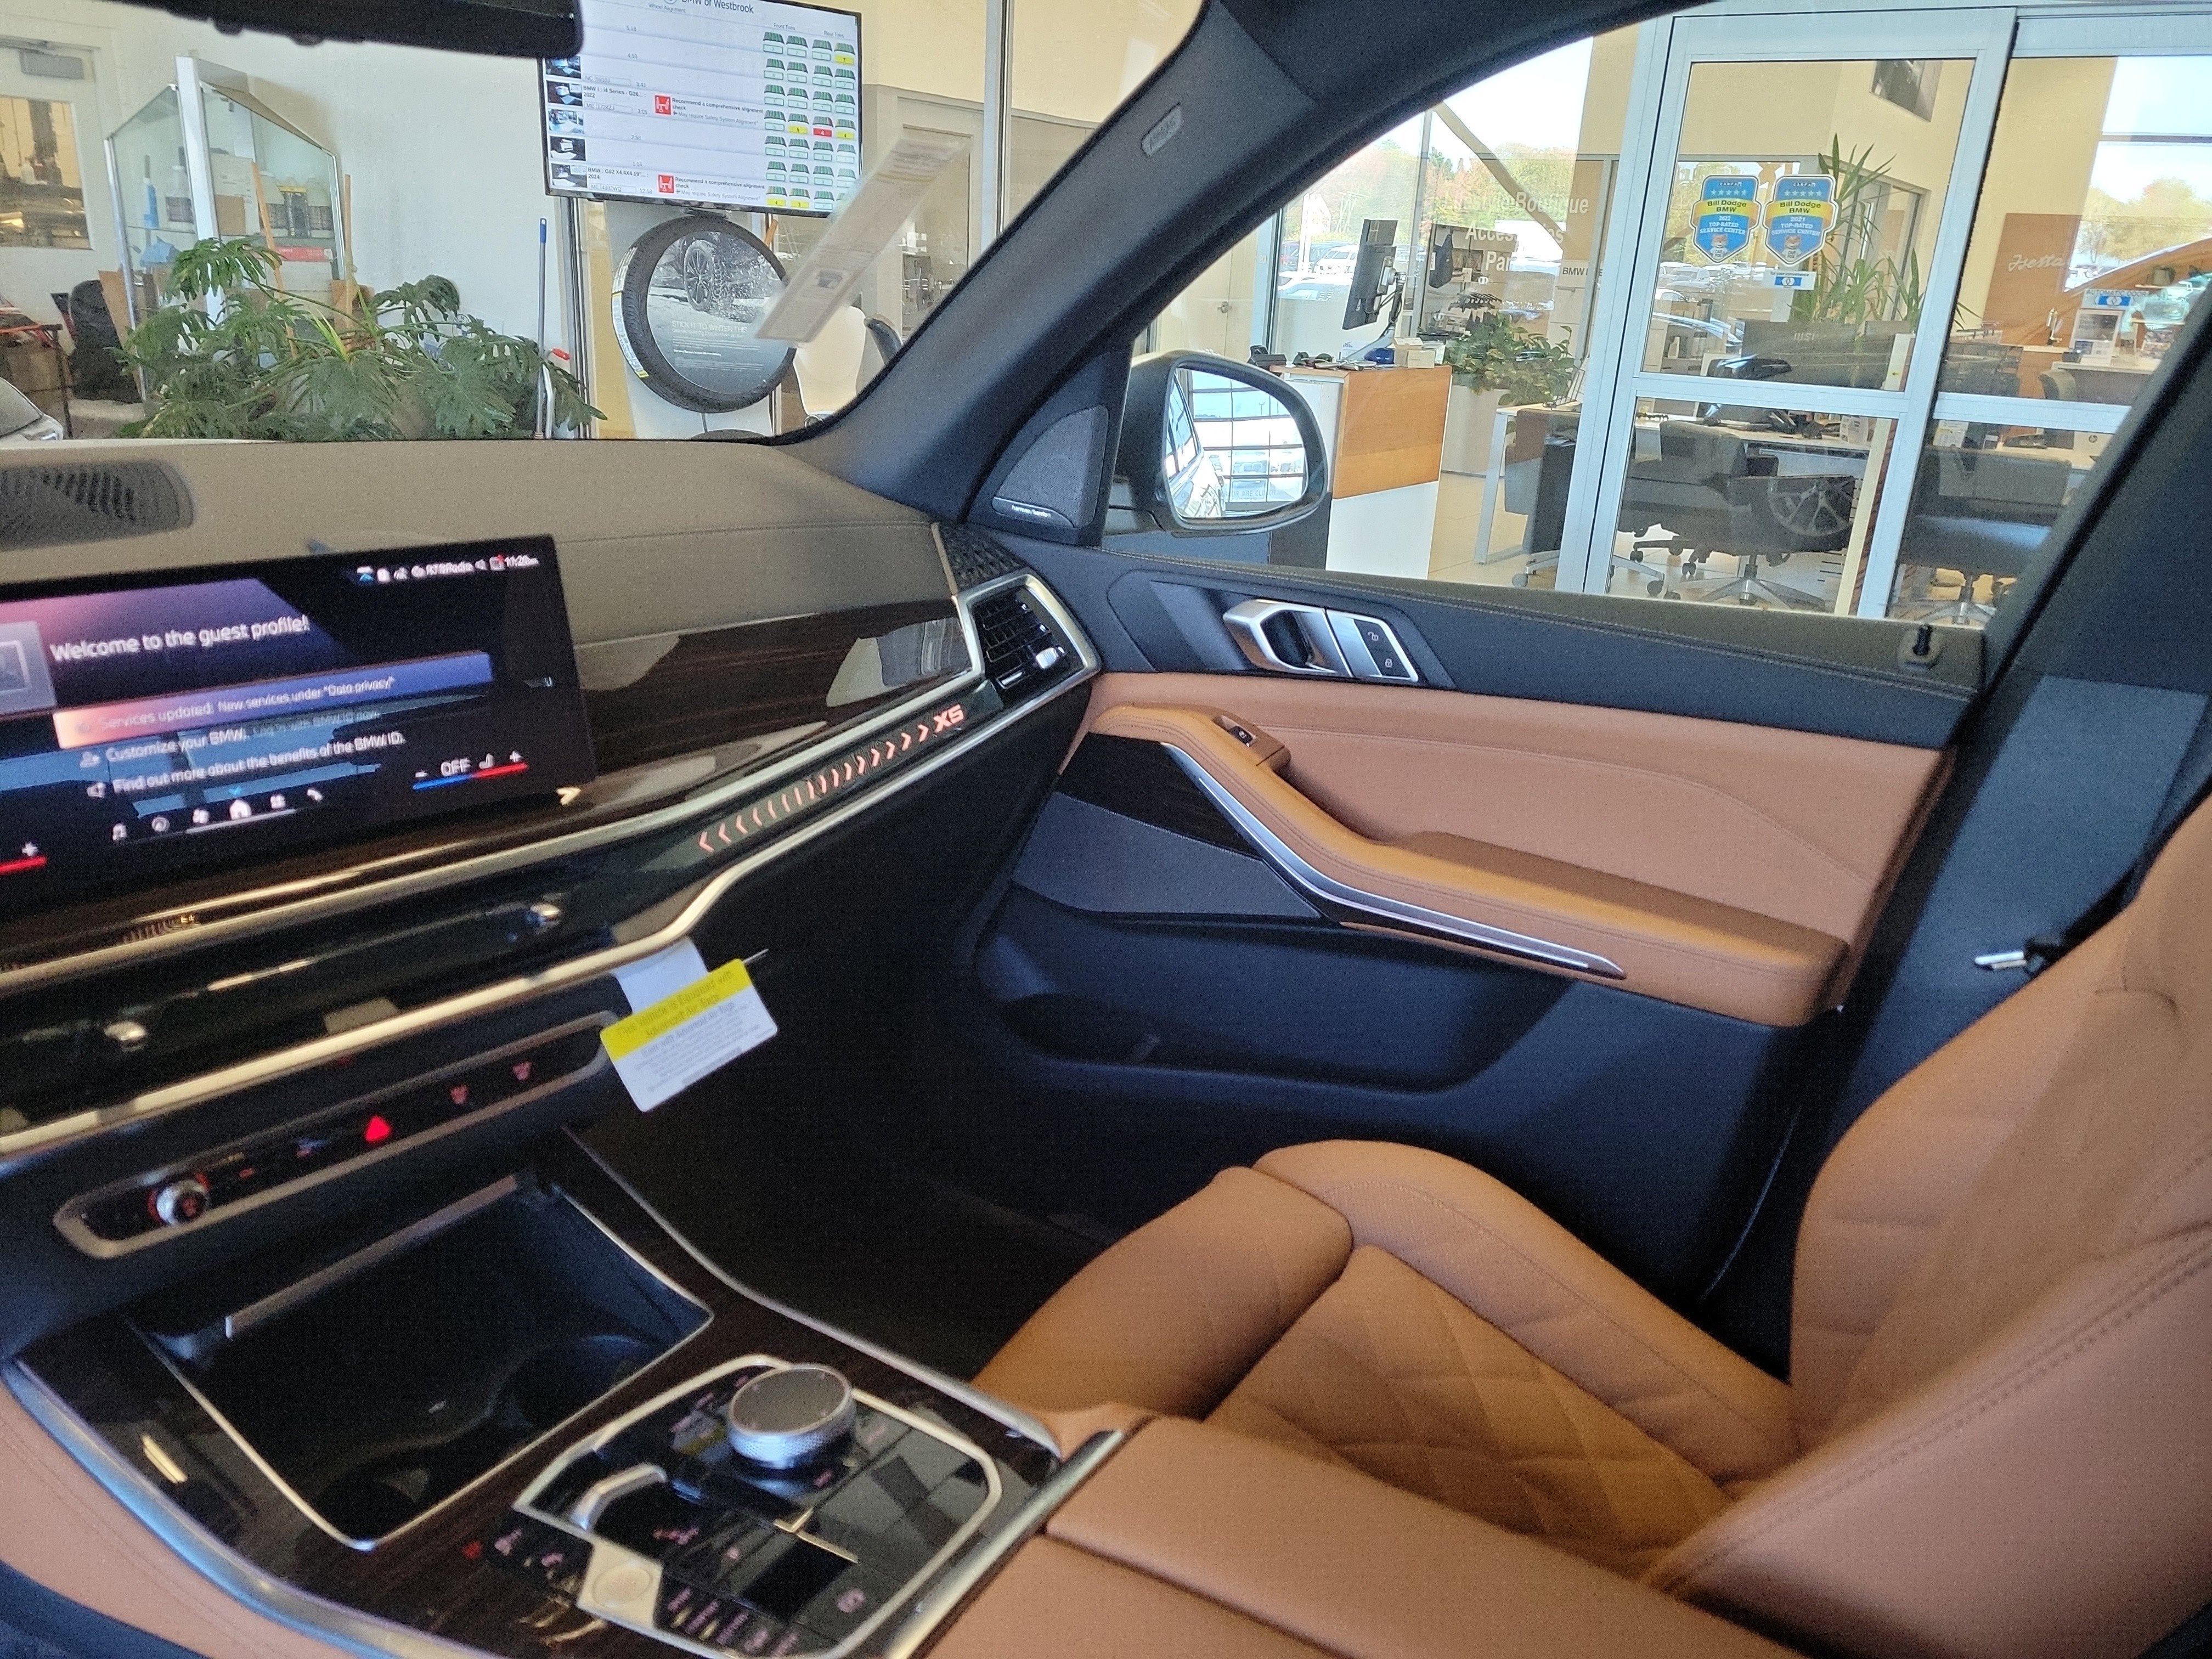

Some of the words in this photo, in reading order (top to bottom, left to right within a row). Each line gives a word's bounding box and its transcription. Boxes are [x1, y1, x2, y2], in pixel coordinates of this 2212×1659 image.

[714, 0, 754, 14] Westbrook
[706, 102, 741, 111] comprehensive
[708, 180, 742, 188] comprehensive
[1516, 191, 1589, 215] Bouue
[1562, 267, 1585, 275] BMW
[709, 324, 732, 332] WINTER
[1012, 505, 1051, 518] harman/kardon
[49, 637, 140, 662] Welcome
[142, 634, 163, 651] to
[165, 630, 197, 648] the
[198, 623, 250, 648] guest
[251, 614, 310, 640] profile!
[99, 713, 155, 730] Services
[217, 699, 244, 712] New
[245, 692, 290, 708] services
[291, 688, 323, 703] under
[290, 719, 311, 731] with
[312, 714, 338, 727] BMW
[933, 704, 964, 732] X5
[106, 741, 178, 763] Customize
[178, 736, 208, 754] your
[112, 775, 146, 793] Find
[146, 774, 170, 788] out
[171, 767, 207, 783] more
[208, 759, 246, 777] about
[246, 755, 269, 769] the
[269, 747, 318, 765] benefits
[318, 742, 334, 757] of
[334, 740, 354, 754] the
[354, 733, 387, 751] BMW
[441, 758, 471, 776] OFF
